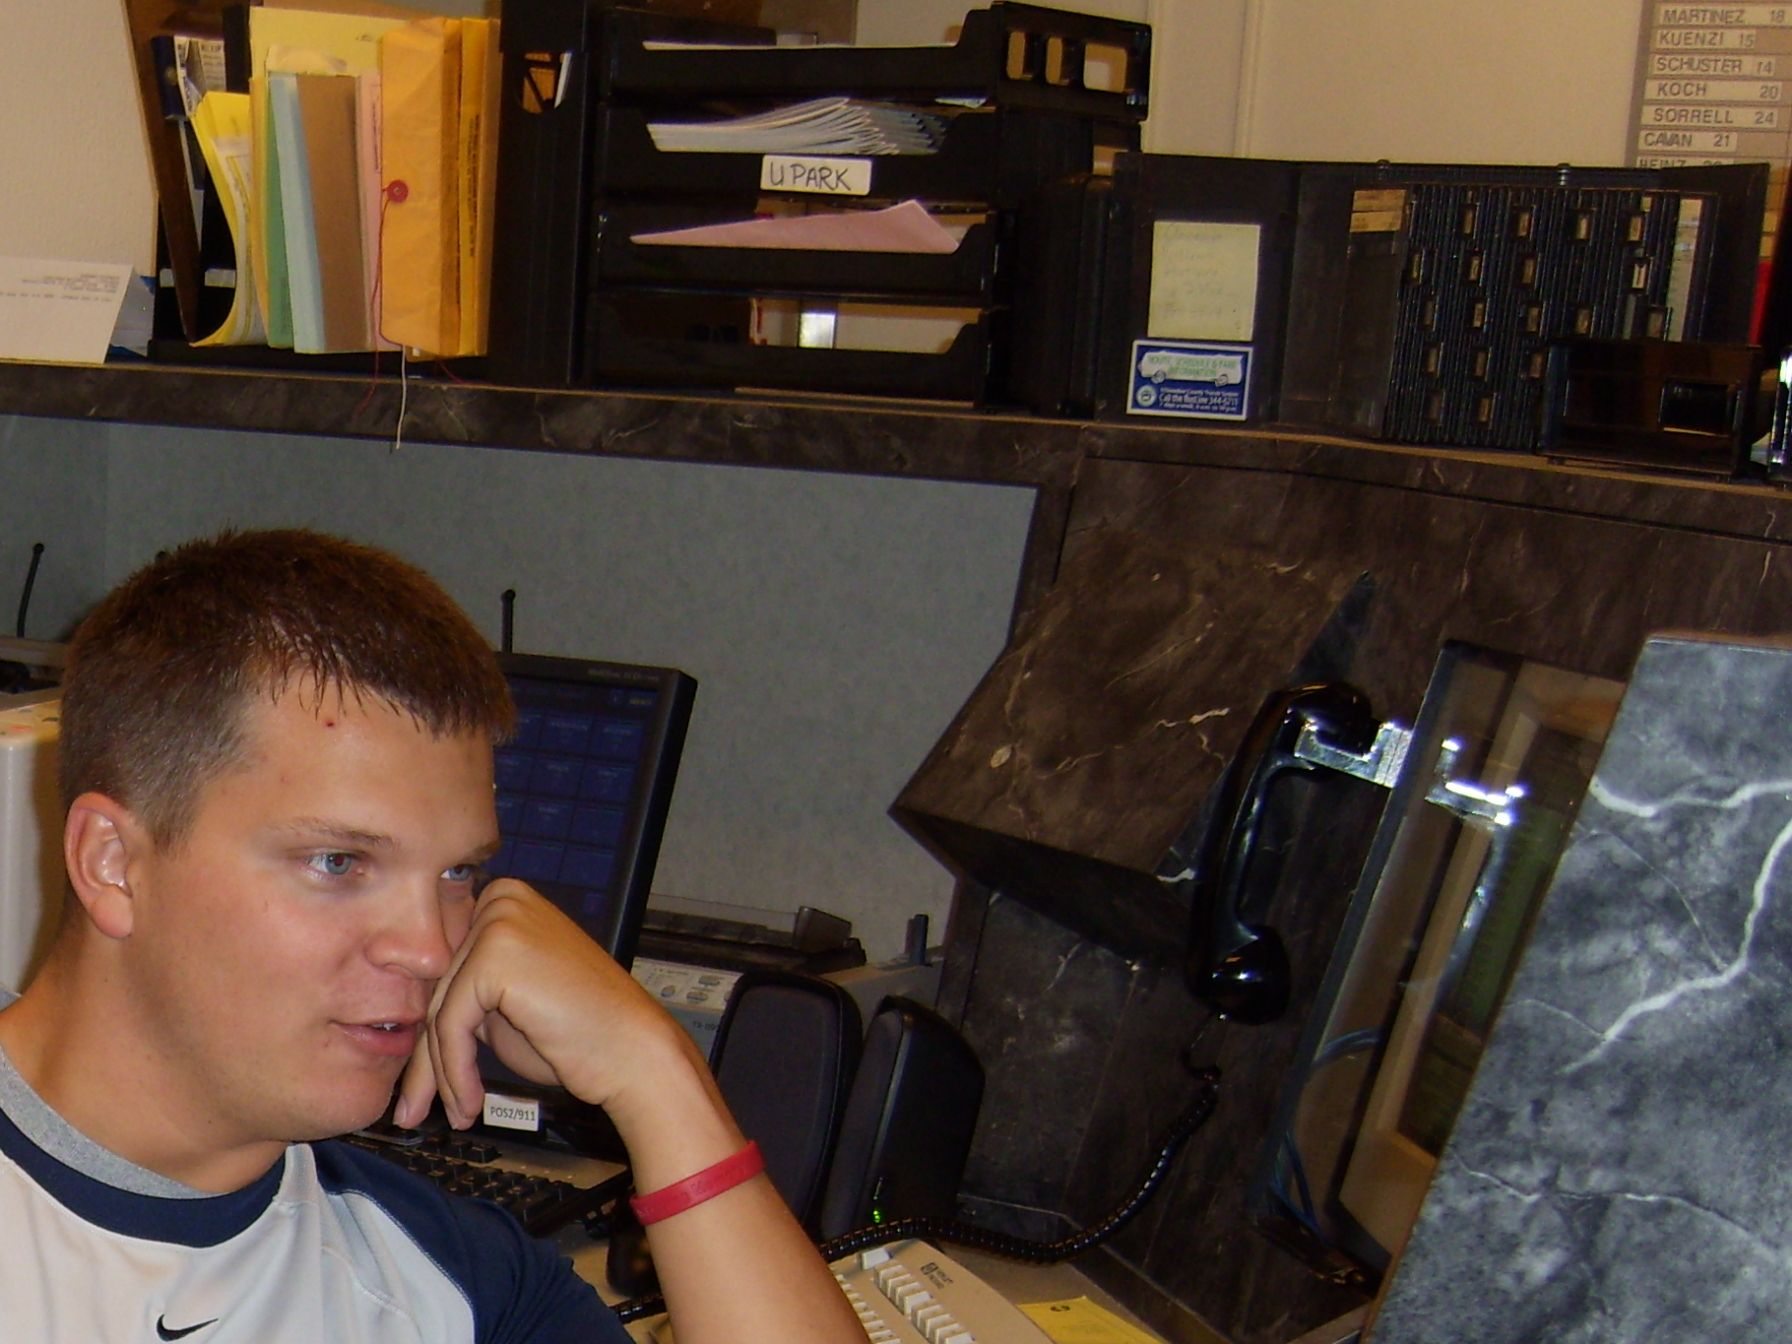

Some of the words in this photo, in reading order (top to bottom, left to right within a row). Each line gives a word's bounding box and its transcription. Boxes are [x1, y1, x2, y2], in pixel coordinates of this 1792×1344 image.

[1663, 9, 1745, 24] MARTINEZ
[1770, 10, 1786, 23] 18
[1659, 31, 1724, 46] KUENZI
[1657, 57, 1743, 73] SCHUSTER
[1658, 82, 1707, 97] KOCH
[1759, 85, 1779, 100] 20
[1653, 108, 1734, 125] SORRELL
[1754, 111, 1775, 125] 24
[1644, 132, 1693, 148] CAVAN
[1713, 134, 1730, 148] 21
[770, 161, 785, 187] U
[789, 163, 852, 192] PARK
